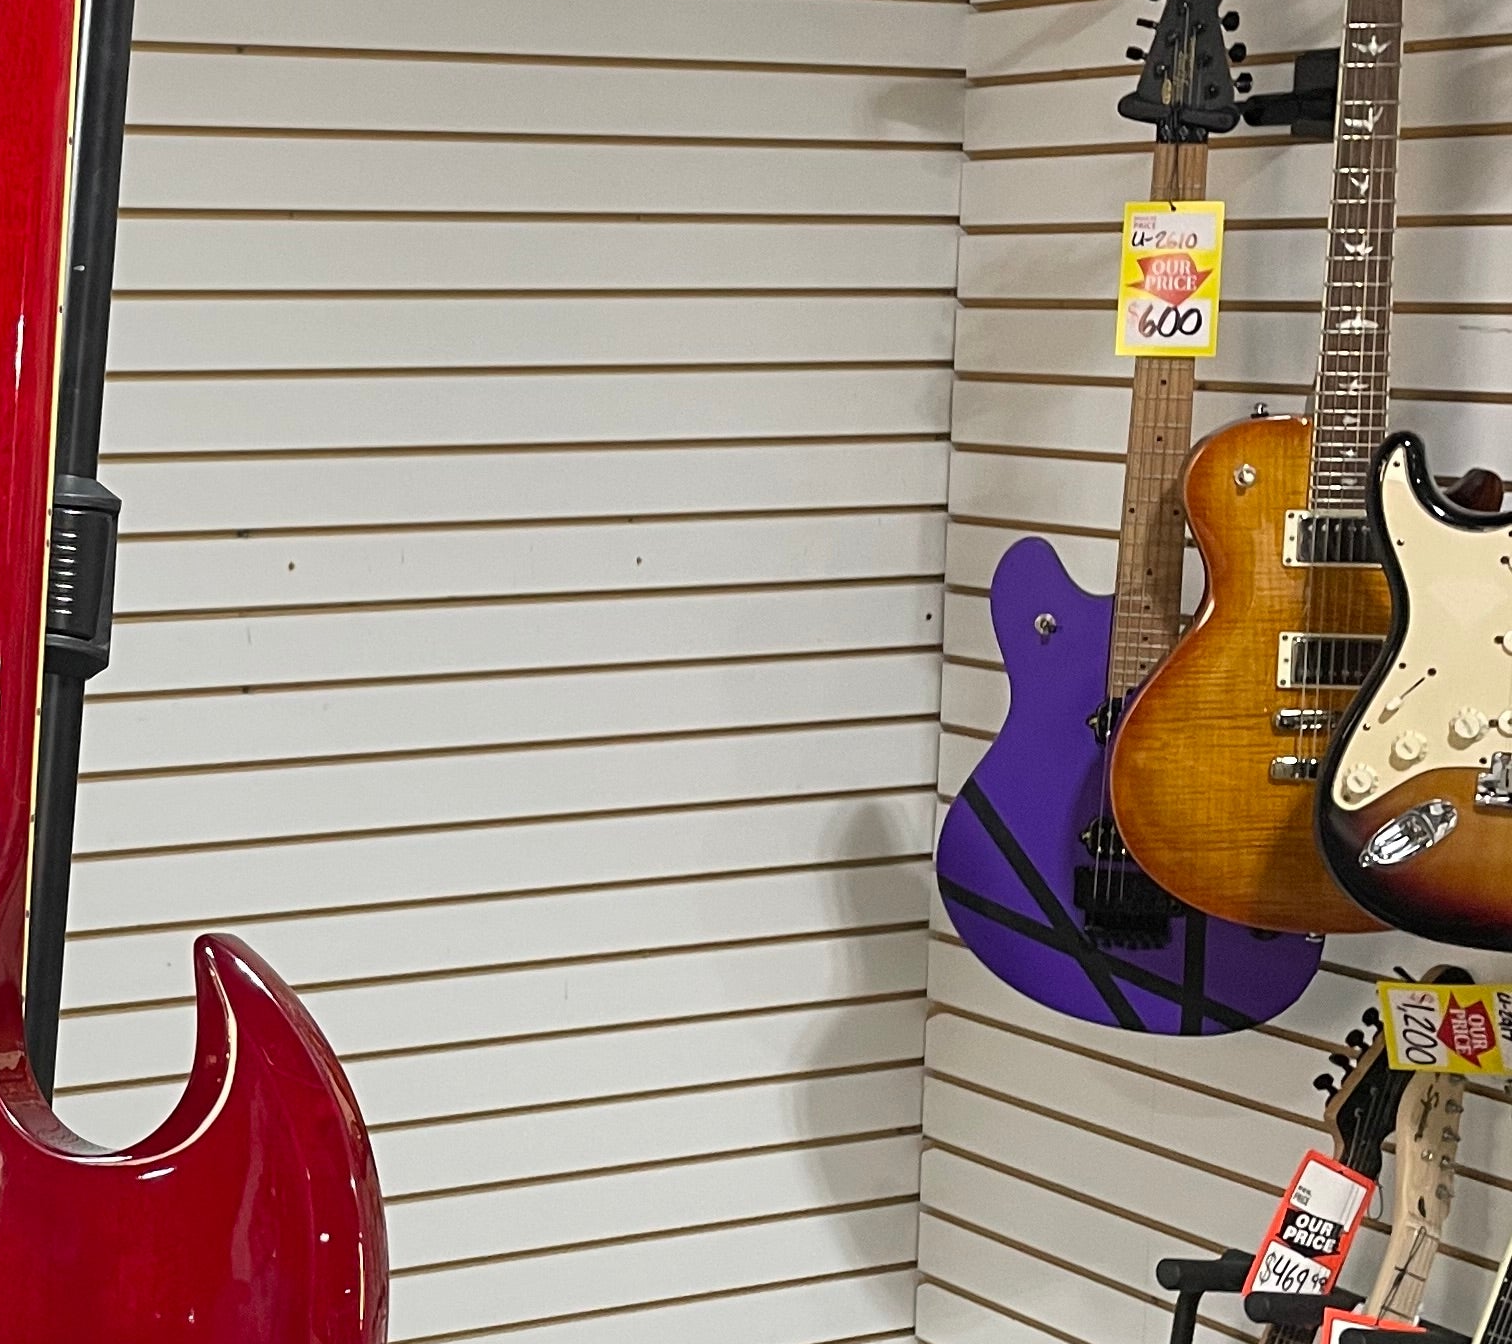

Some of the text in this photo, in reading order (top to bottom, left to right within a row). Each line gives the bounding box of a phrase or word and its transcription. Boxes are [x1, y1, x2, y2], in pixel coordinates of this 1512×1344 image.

[1151, 259, 1191, 275] OUR
[1144, 275, 1197, 291] PRICE
[1449, 1008, 1472, 1056] PRICE
[1468, 1014, 1488, 1050] OUR
[1295, 1213, 1334, 1237] OUR
[1282, 1225, 1336, 1254] PRICE
